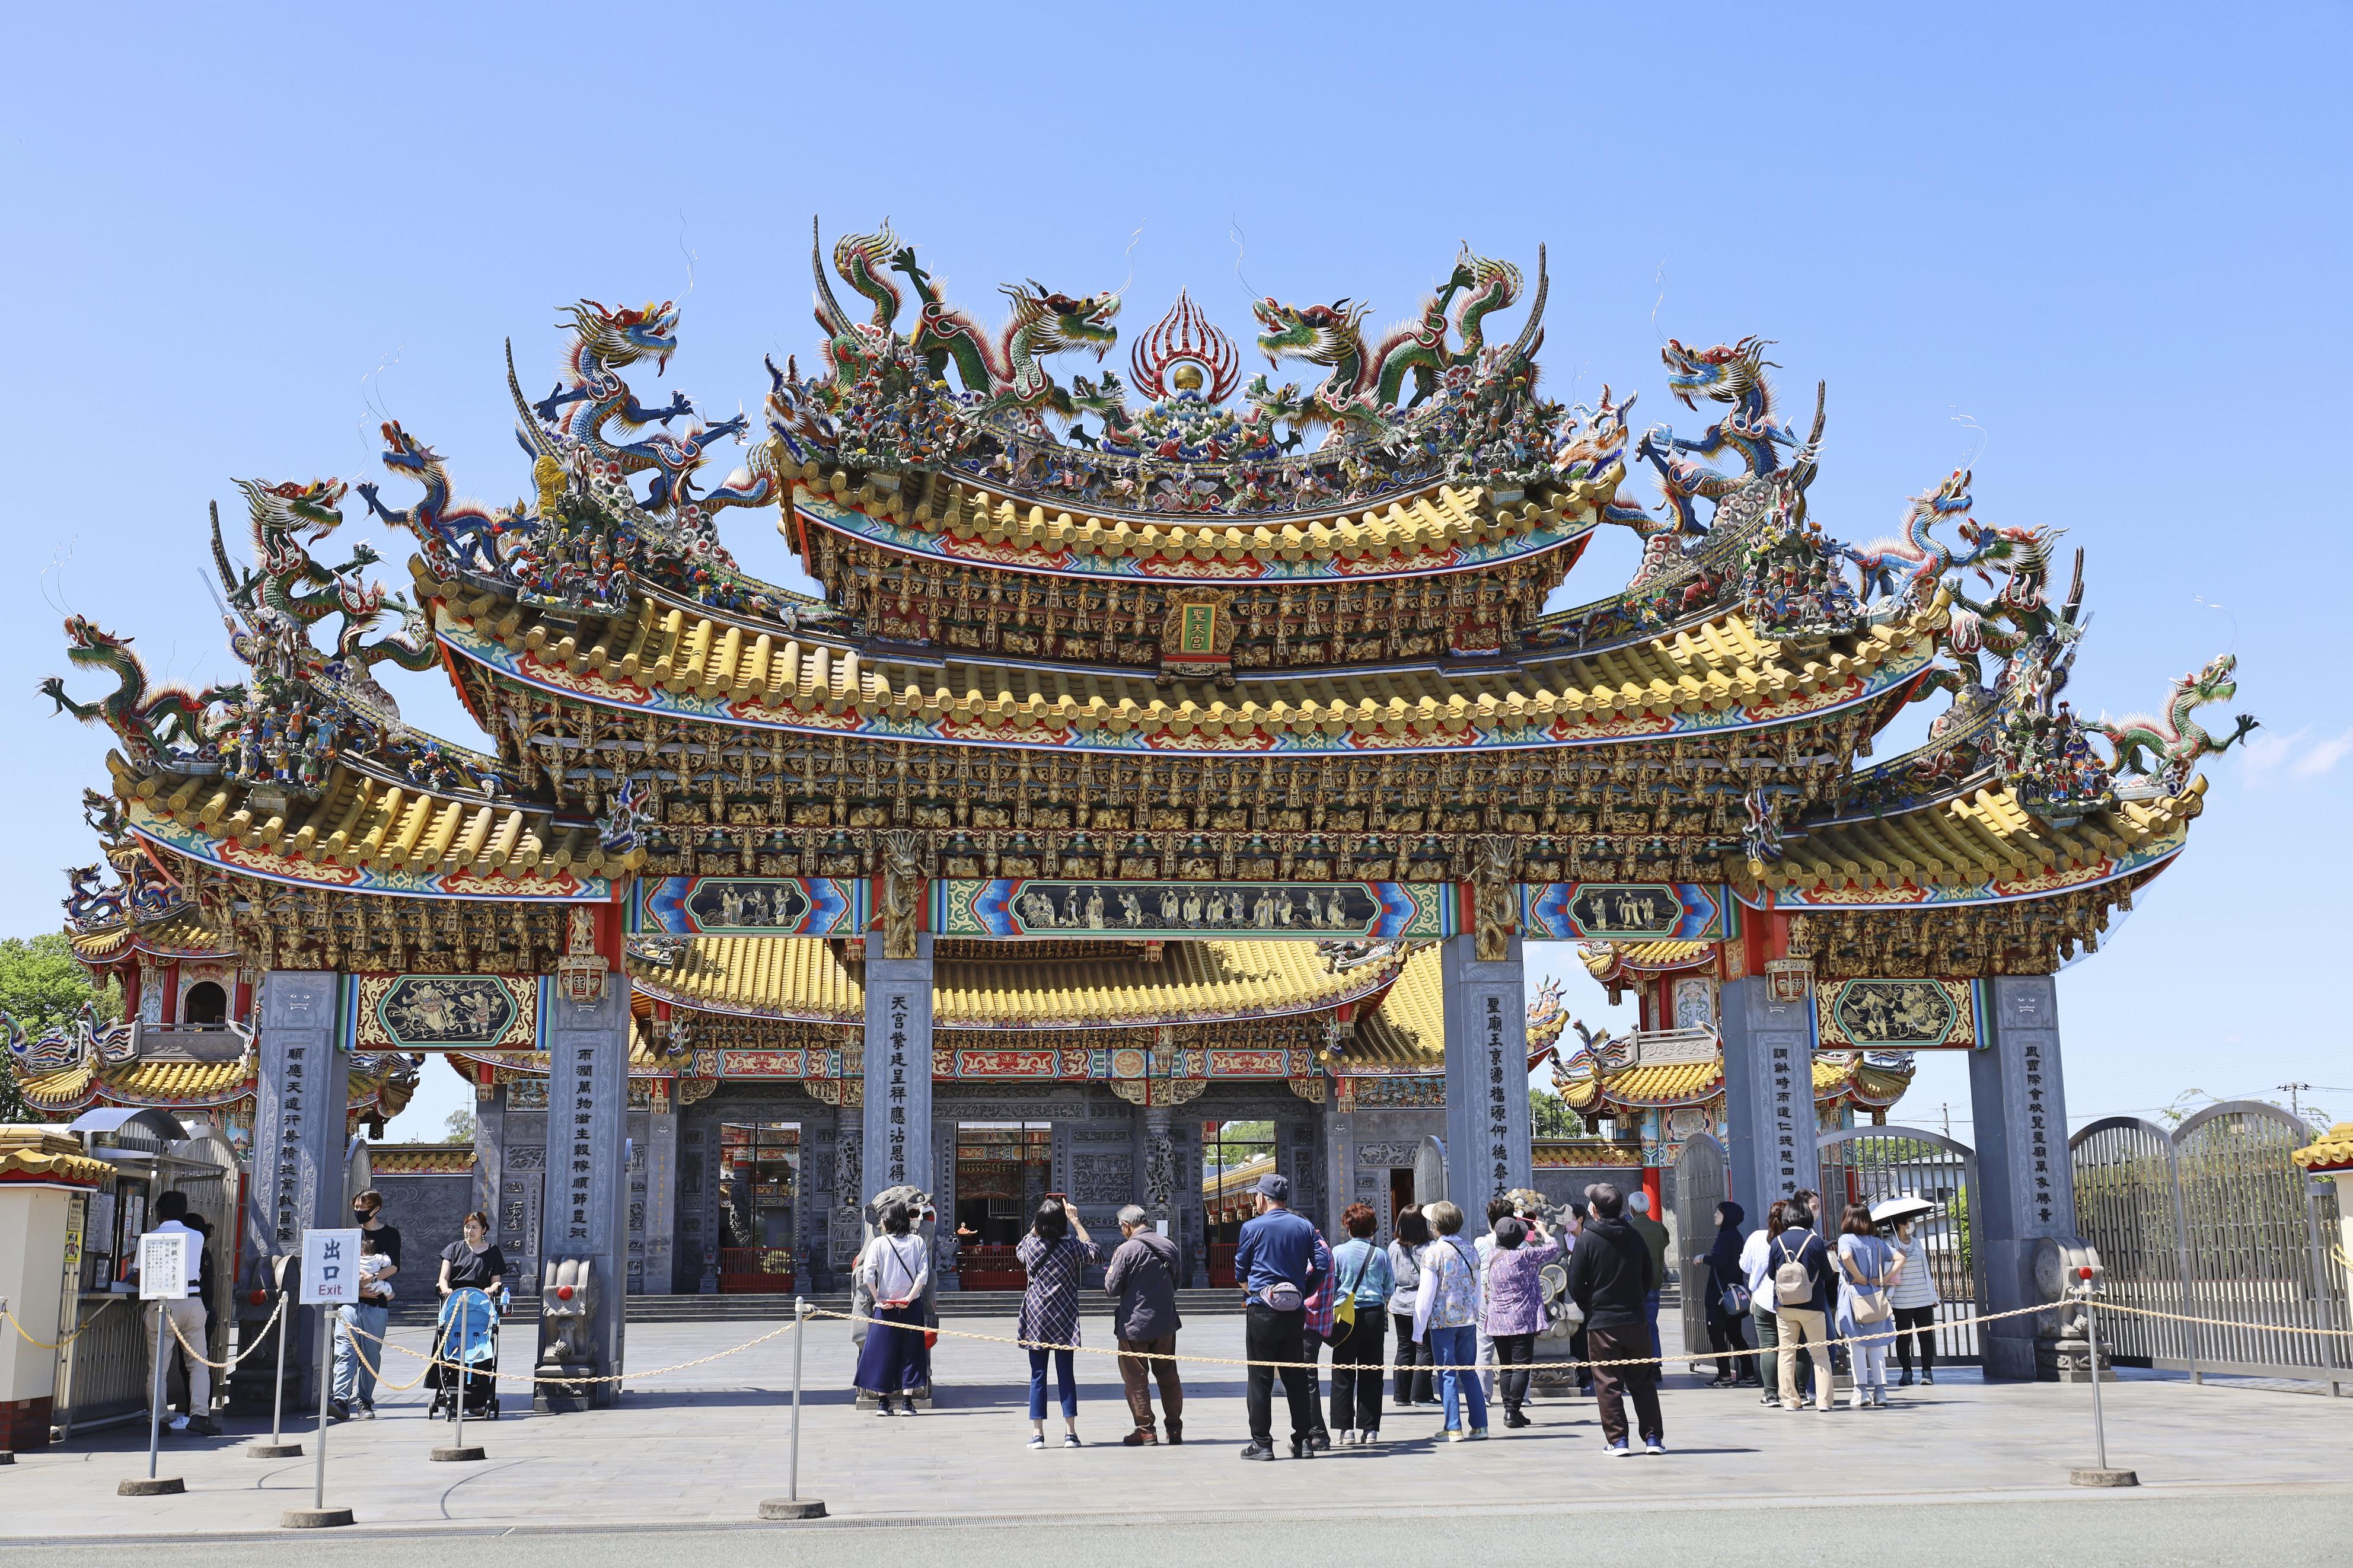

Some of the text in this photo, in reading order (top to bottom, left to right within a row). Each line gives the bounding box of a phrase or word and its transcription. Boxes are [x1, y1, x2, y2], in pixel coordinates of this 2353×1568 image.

[1191, 608, 1207, 649] 聖天宮
[888, 996, 908, 1187] 天宮紫廷呈祥應沾恩得
[322, 1238, 341, 1281] 出口
[318, 1284, 342, 1295] Exit
